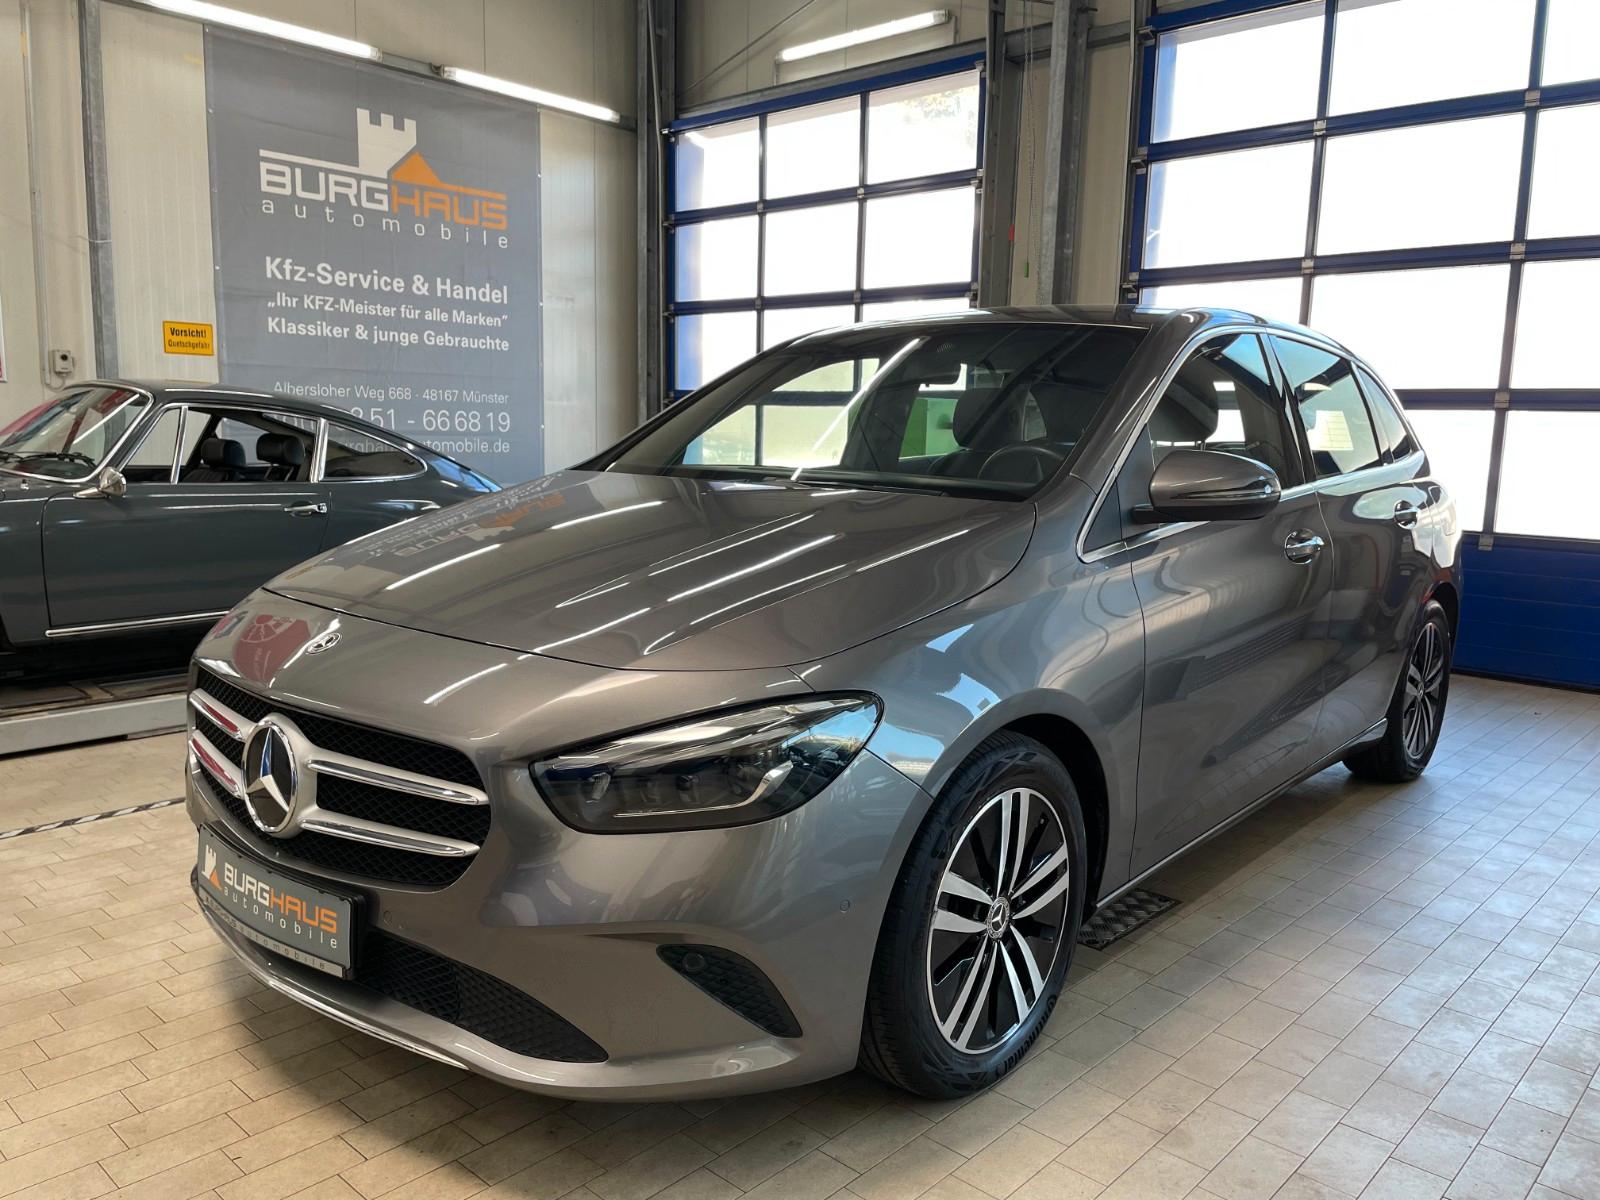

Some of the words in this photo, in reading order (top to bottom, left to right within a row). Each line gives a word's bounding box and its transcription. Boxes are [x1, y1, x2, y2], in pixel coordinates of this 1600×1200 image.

[259, 161, 508, 231] BURGHAUS
[261, 199, 509, 249] automobile
[265, 256, 405, 293] Kfz-Service
[411, 274, 430, 296] &
[436, 277, 508, 304] Handel
[303, 294, 397, 317] KFZ-Meister
[400, 304, 421, 320] für
[424, 307, 449, 322] alle
[170, 327, 207, 338] Vorsicht!
[267, 316, 350, 339] Klassiker
[355, 323, 369, 341] &
[372, 326, 419, 346] junge
[423, 330, 510, 351] Gebrauchte
[273, 381, 351, 398] Albersloher
[354, 384, 385, 401] Weg
[388, 387, 412, 401] 668
[422, 388, 459, 402] 48167
[461, 389, 510, 404] Münster
[223, 886, 338, 949] automobile
[224, 862, 338, 934] BURGHAUS
